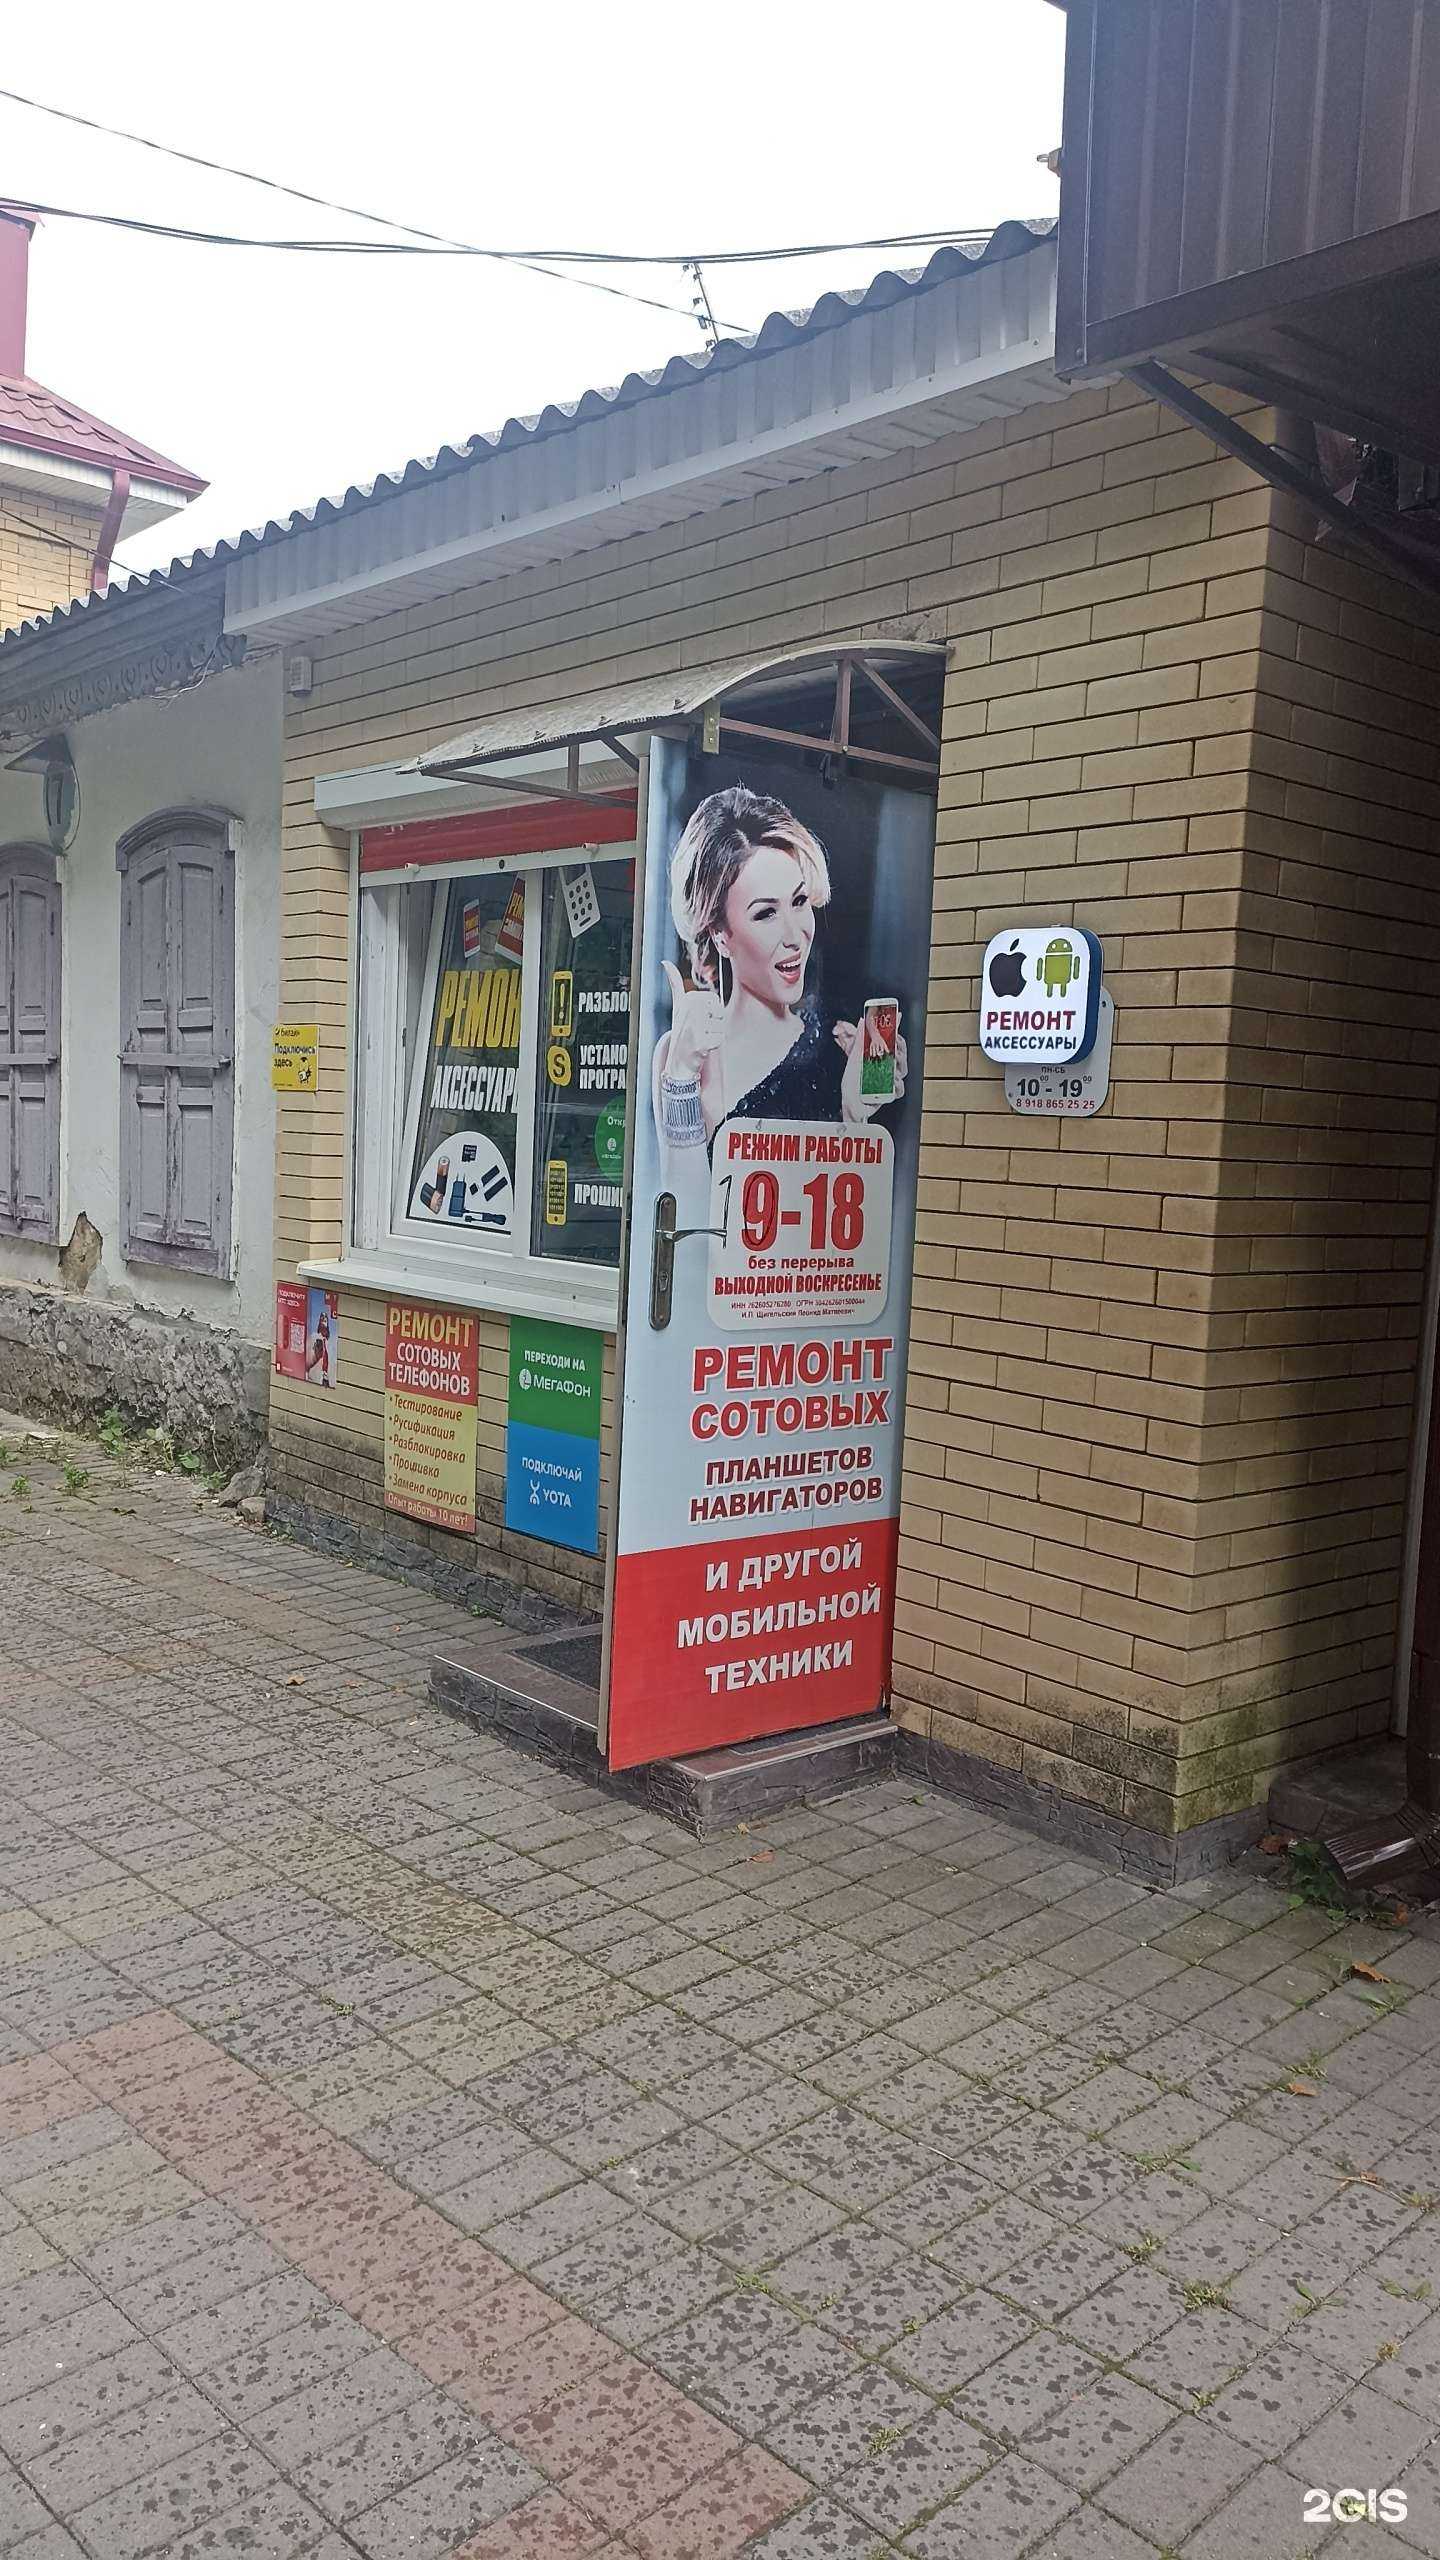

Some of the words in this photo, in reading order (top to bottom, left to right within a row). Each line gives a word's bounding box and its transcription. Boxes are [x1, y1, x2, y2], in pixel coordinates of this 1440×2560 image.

[986, 1010, 1077, 1031] РЕМОНТ
[274, 1043, 316, 1055] Подключись
[984, 1036, 1077, 1050] АКСЕССУАРЫ
[273, 1058, 293, 1068] здесь
[1041, 1066, 1066, 1074] ПН-СБ
[1016, 1099, 1022, 1108] 8
[1025, 1099, 1043, 1108] 918
[1046, 1099, 1064, 1109] 865
[1067, 1100, 1079, 1109] 25
[1082, 1100, 1095, 1110] 25
[728, 1132, 800, 1162] РЕЖИМ
[804, 1135, 883, 1164] РАБОТЫ
[748, 1255, 776, 1270] без
[781, 1256, 855, 1272] перерыва
[715, 1273, 793, 1297] ВЫХОДНОЙ
[796, 1273, 882, 1293] ВОСКРЕСЕНЬЕ
[389, 1307, 474, 1347] РЕМОНТ
[397, 1342, 461, 1371] СОТОВЫХ
[524, 1350, 571, 1369] ПЕРЕХОДИ
[572, 1358, 586, 1371] НА
[693, 1338, 893, 1392] РЕМОНТ
[388, 1362, 470, 1396] ТЕЛЕФОНОВ
[394, 1394, 463, 1421] Тестирование
[691, 1390, 890, 1440] СОТОВЫХ
[393, 1414, 455, 1440] Русификация
[393, 1434, 466, 1464] Разблокировка
[393, 1453, 440, 1478] Прошивка
[521, 1456, 583, 1482] ПОДКЛЮЧАЙ
[706, 1446, 873, 1486] ПЛАНШЕТОВ
[392, 1473, 425, 1494] Замена
[427, 1486, 467, 1506] корпуса
[689, 1477, 882, 1522] НАВИГАТОРОВ
[388, 1493, 407, 1508] Опыт
[407, 1499, 437, 1518] работы
[439, 1508, 449, 1521] 10
[449, 1512, 469, 1527] лет!
[705, 1561, 729, 1591] И
[737, 1537, 863, 1592] ДРУГОЙ
[677, 1582, 882, 1649] МОБИЛЬНОЙ
[705, 1639, 854, 1694] ТЕХНИКИ
